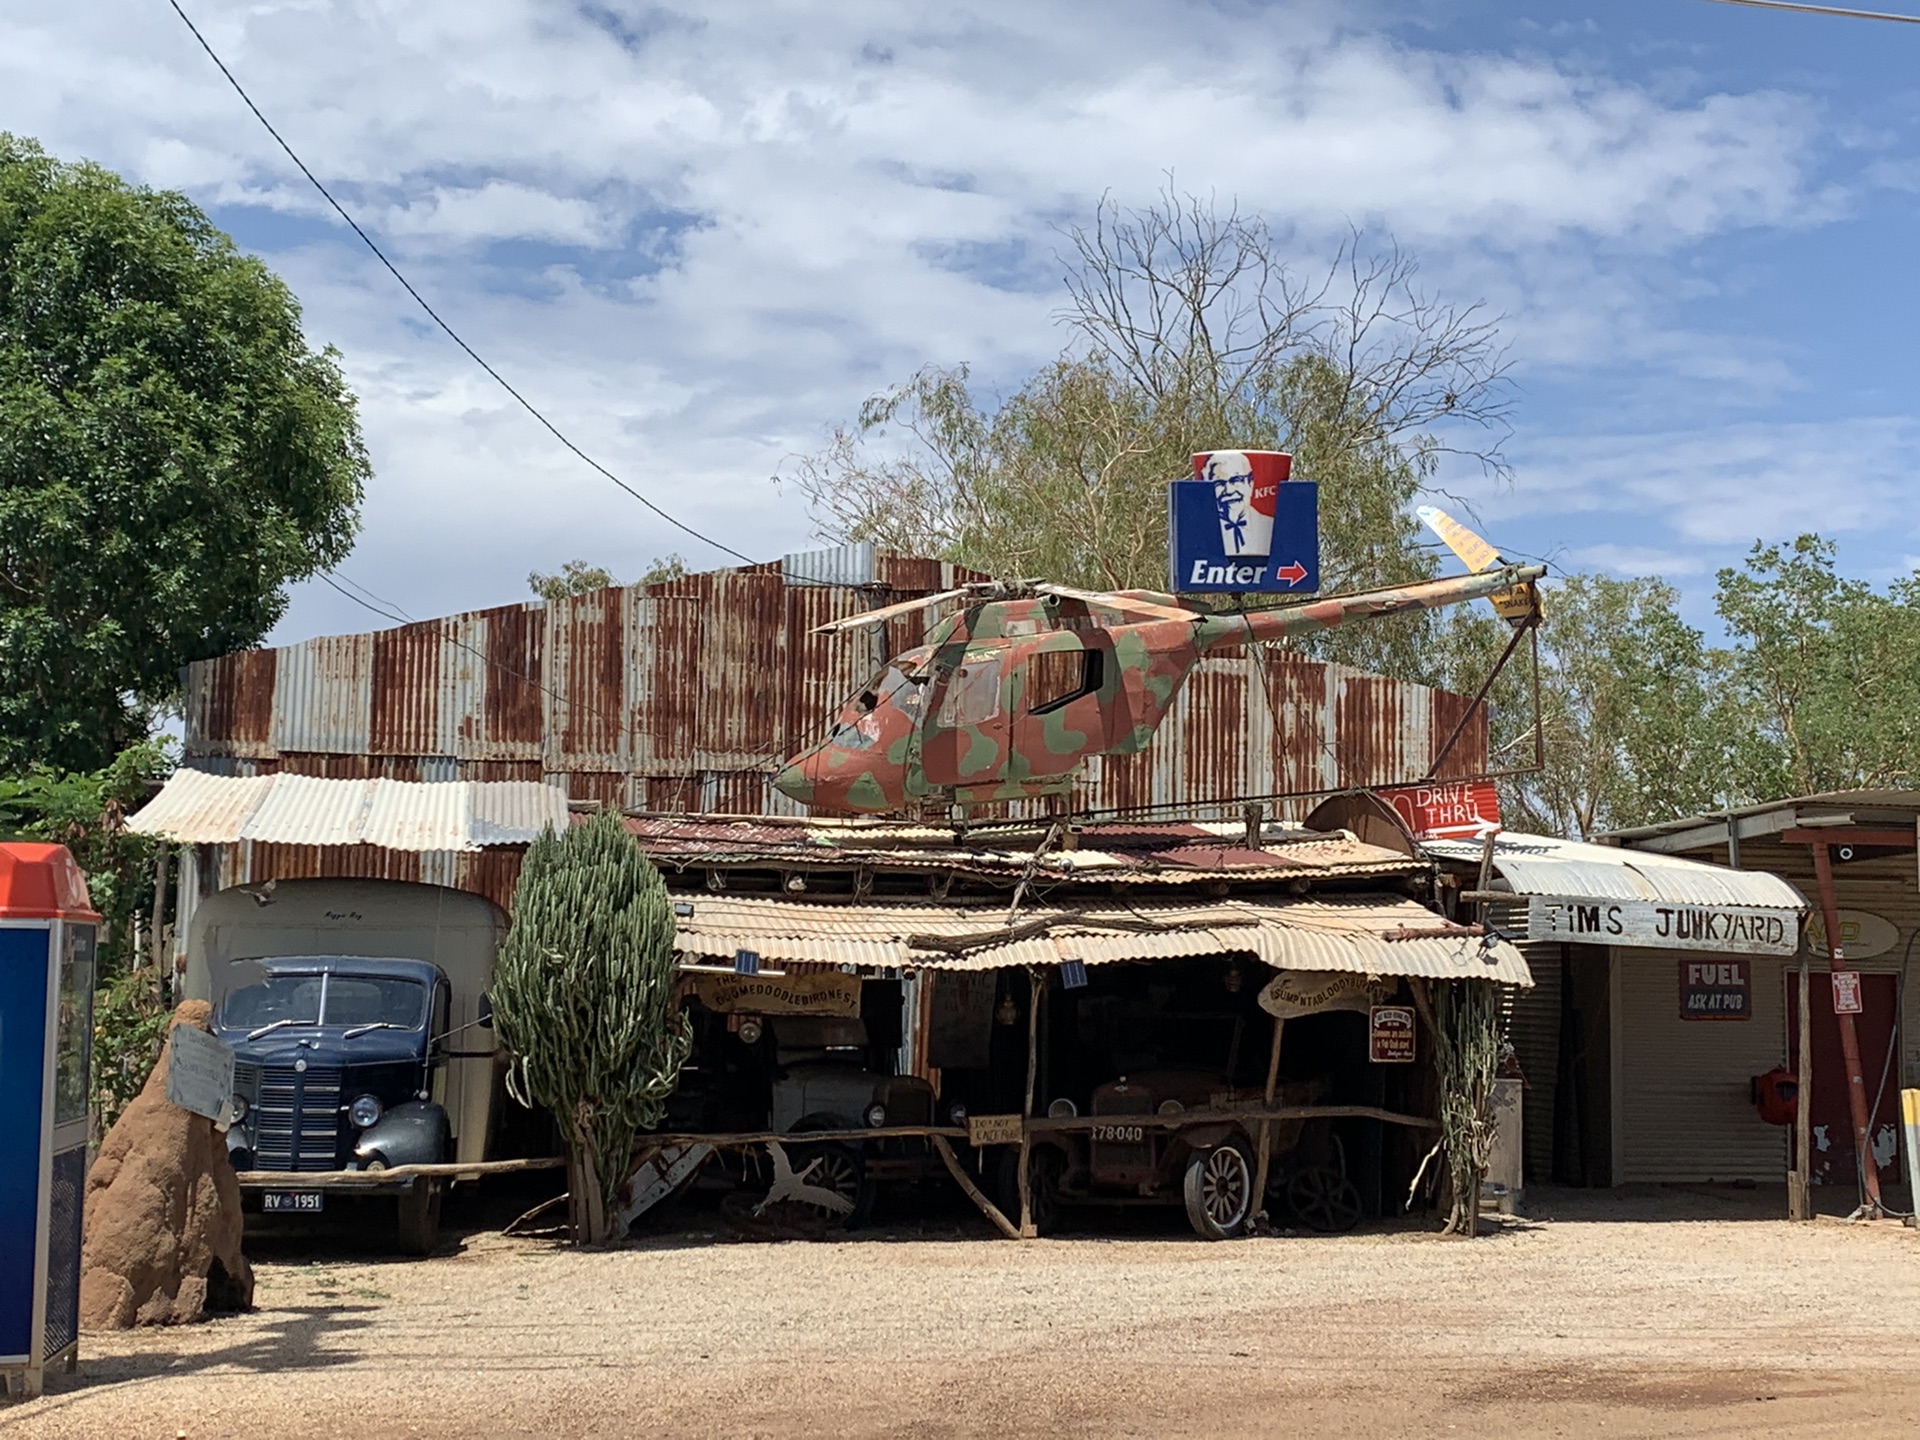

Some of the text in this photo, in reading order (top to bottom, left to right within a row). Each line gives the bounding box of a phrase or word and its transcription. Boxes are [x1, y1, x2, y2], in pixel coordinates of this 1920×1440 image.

[1254, 485, 1276, 499] KFC
[1189, 560, 1267, 584] Enter
[1416, 784, 1475, 807] DRIVE
[1425, 802, 1479, 824] THRU
[1655, 907, 1784, 944] JUNKYARD
[715, 975, 737, 987] THE
[1688, 964, 1745, 985] FUEL
[1687, 993, 1743, 1010] ASK AT PUB
[264, 1195, 320, 1208] RV 1951
